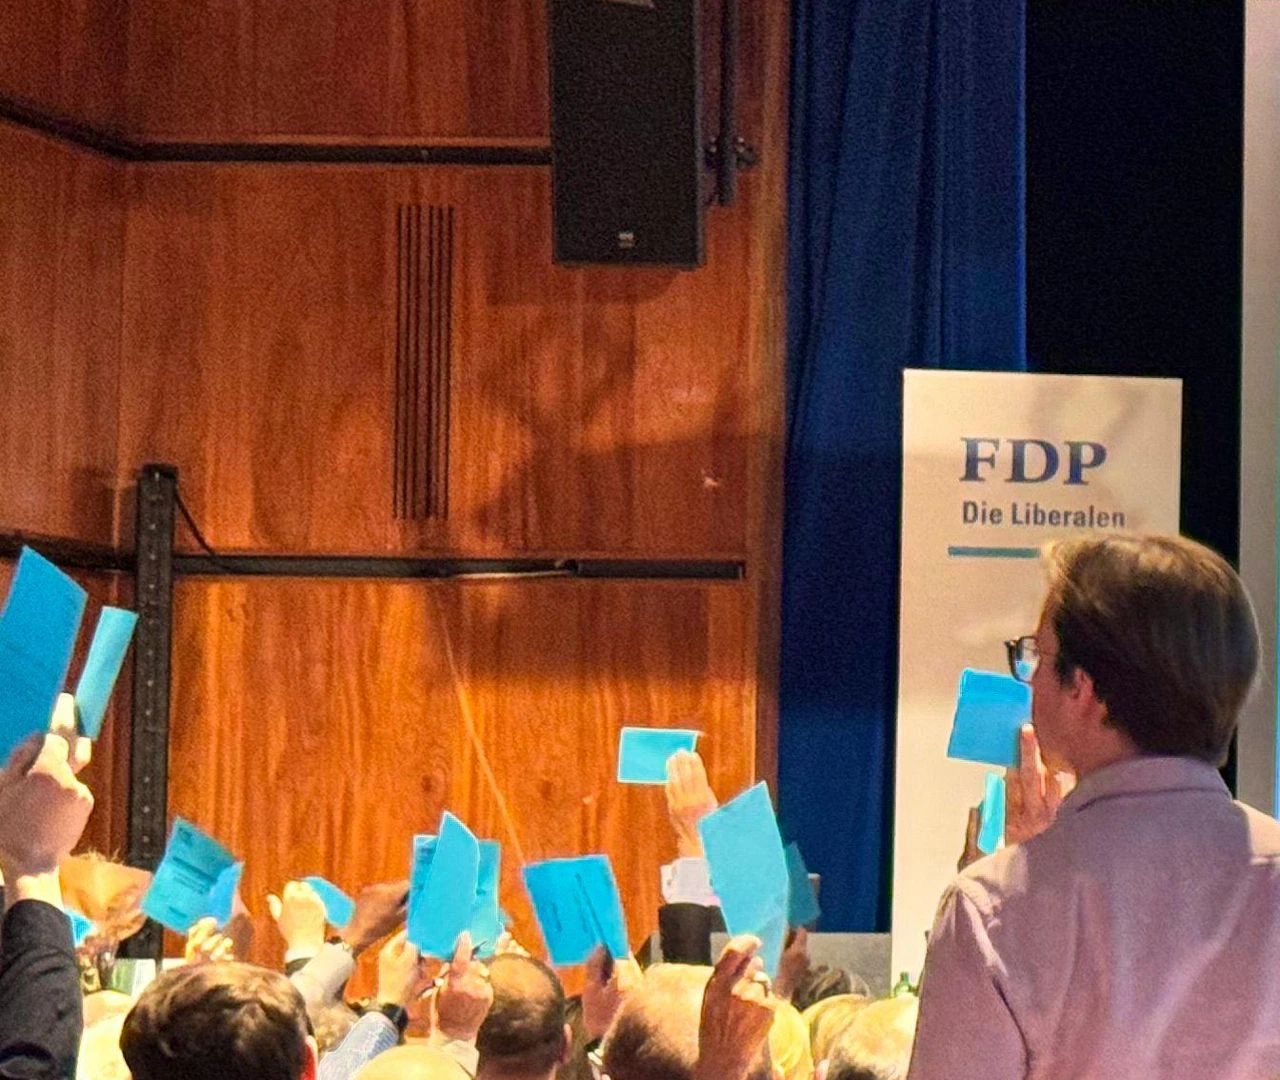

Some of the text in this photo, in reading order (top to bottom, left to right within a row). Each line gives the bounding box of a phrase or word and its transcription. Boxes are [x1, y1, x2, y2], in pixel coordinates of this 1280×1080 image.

[959, 437, 1108, 486] FDP
[962, 500, 1126, 528] Die Liberalen
